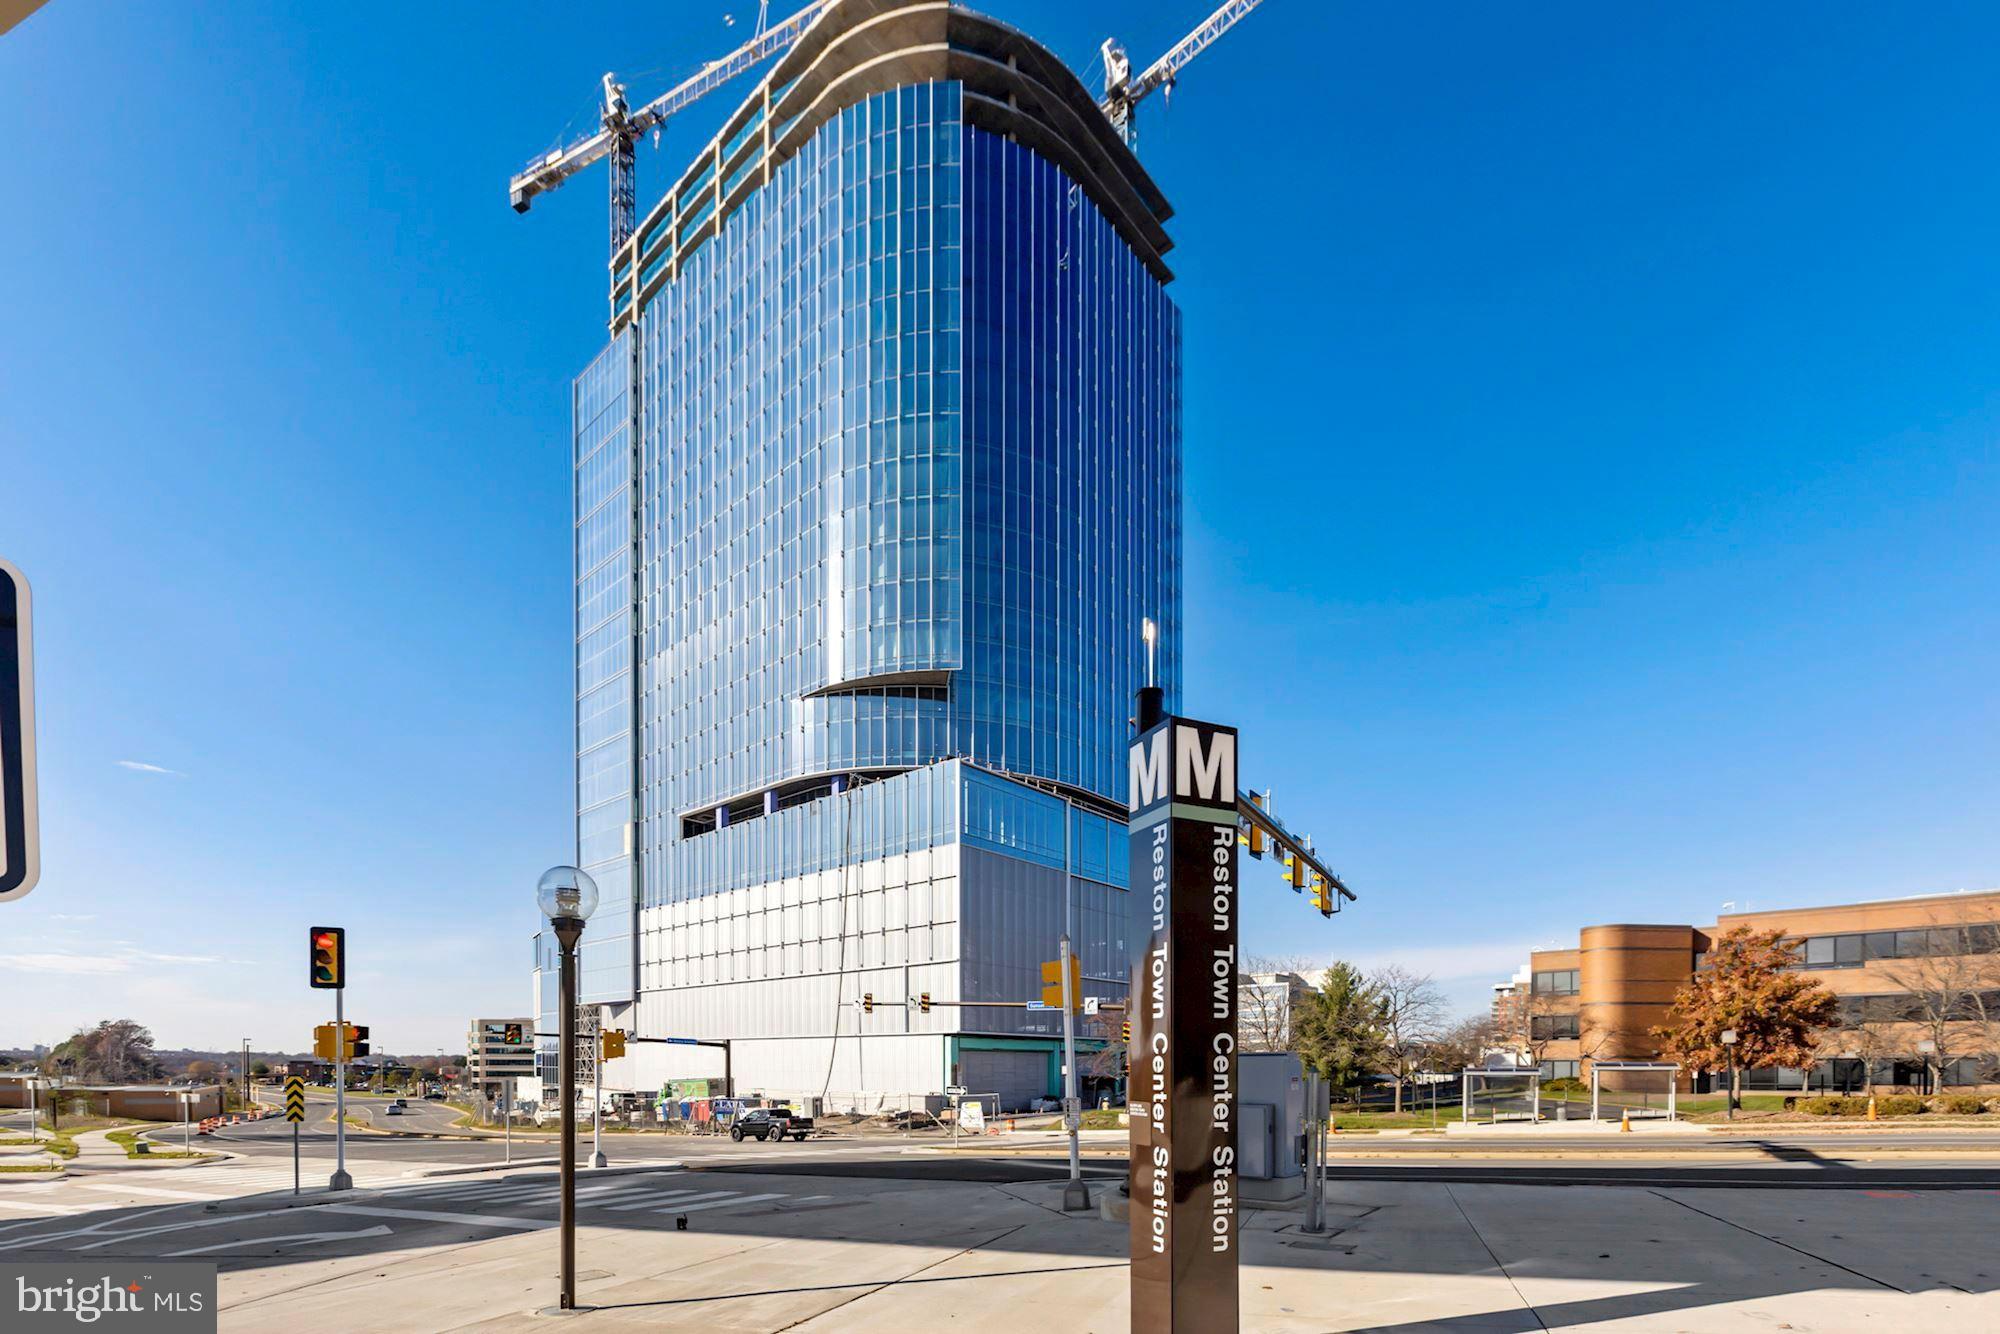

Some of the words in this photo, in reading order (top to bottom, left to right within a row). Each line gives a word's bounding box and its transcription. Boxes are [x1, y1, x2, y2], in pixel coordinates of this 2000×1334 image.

[1130, 727, 1168, 813] M
[1176, 725, 1235, 803] M
[1153, 823, 1167, 931] Reston
[1213, 826, 1234, 931] Reston
[1152, 942, 1168, 1019] Town
[1213, 944, 1234, 1019] Town
[1152, 1032, 1169, 1134] Center
[1213, 1032, 1234, 1133] Center
[1152, 1146, 1169, 1253] Station
[1212, 1145, 1234, 1252] Station
